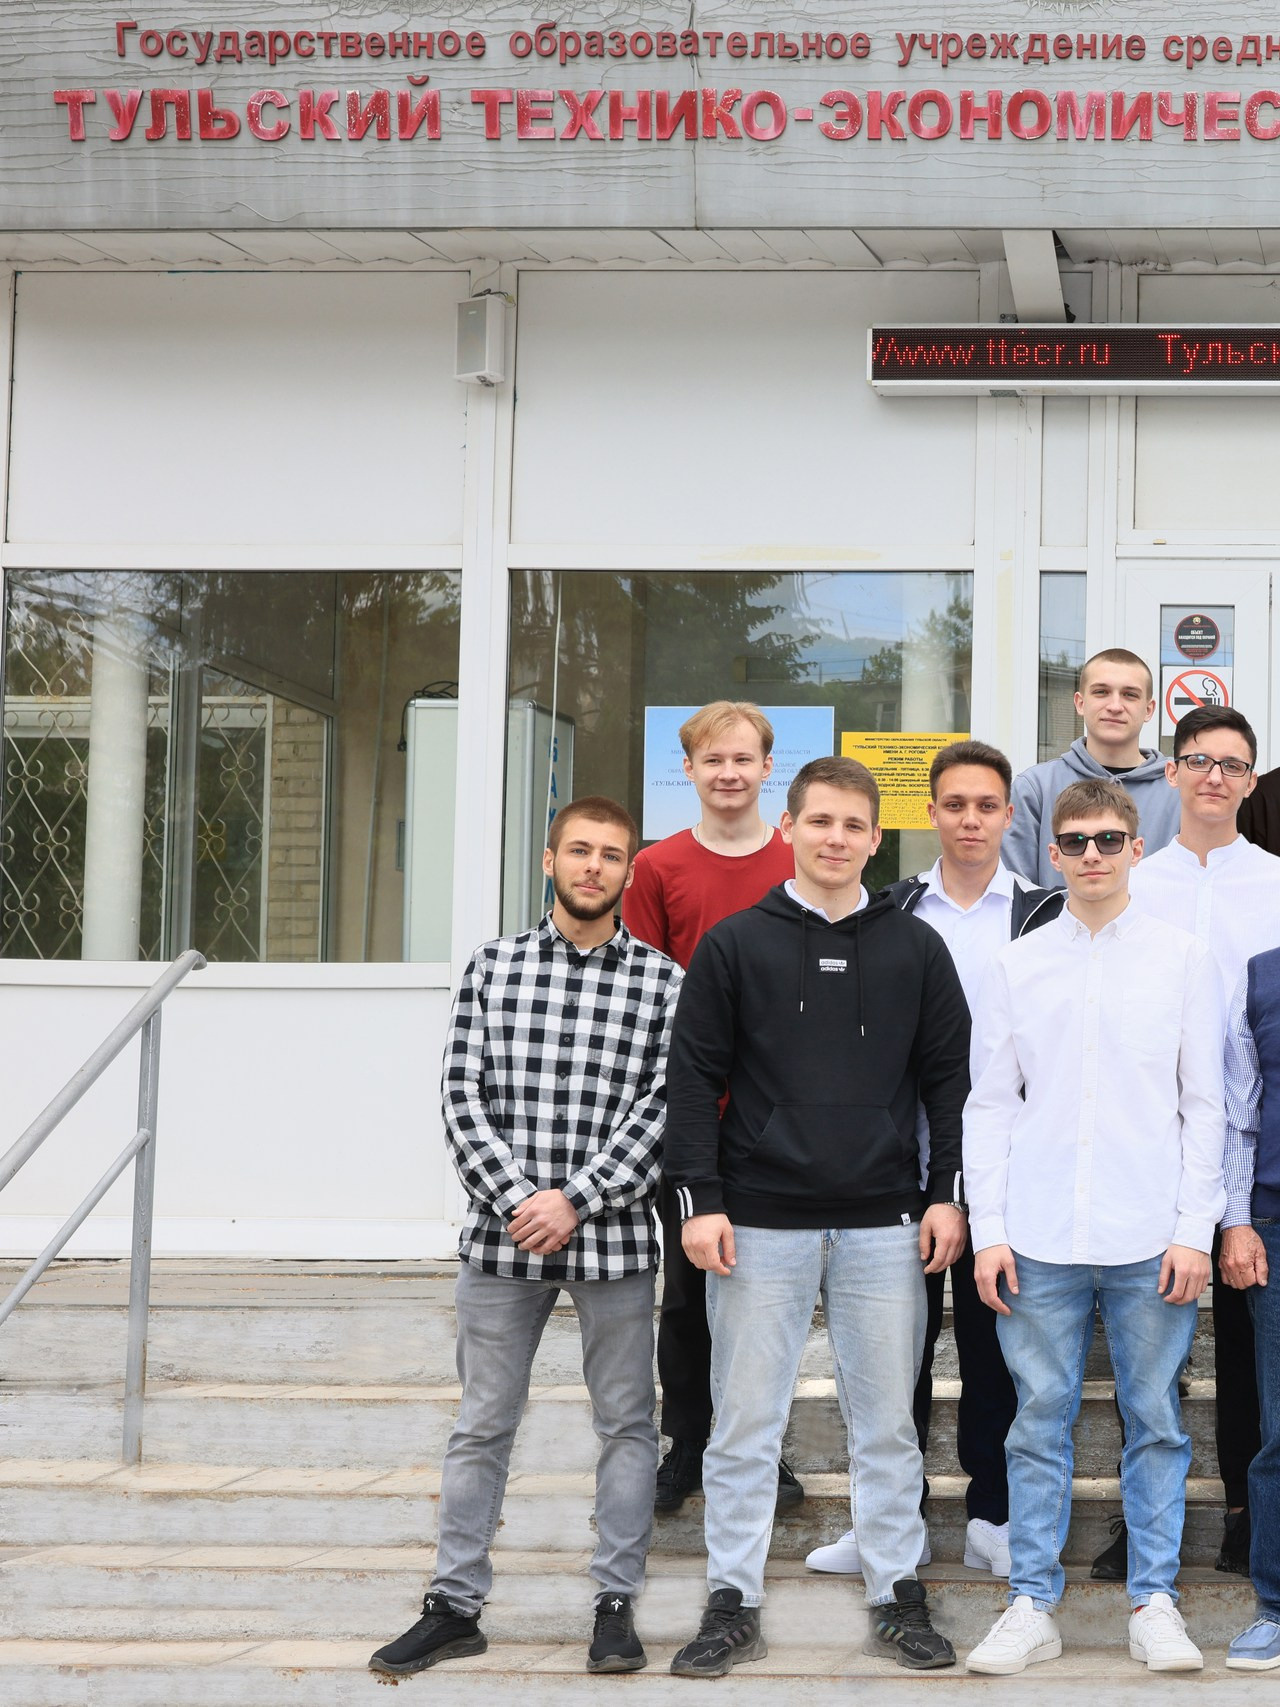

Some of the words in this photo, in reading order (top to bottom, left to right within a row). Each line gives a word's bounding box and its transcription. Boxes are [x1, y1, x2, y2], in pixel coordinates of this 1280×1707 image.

[115, 21, 486, 66] Государственное
[509, 22, 872, 66] образовательное
[896, 32, 1147, 67] учреждение
[53, 75, 442, 142] ТУЛЬСКИЙ
